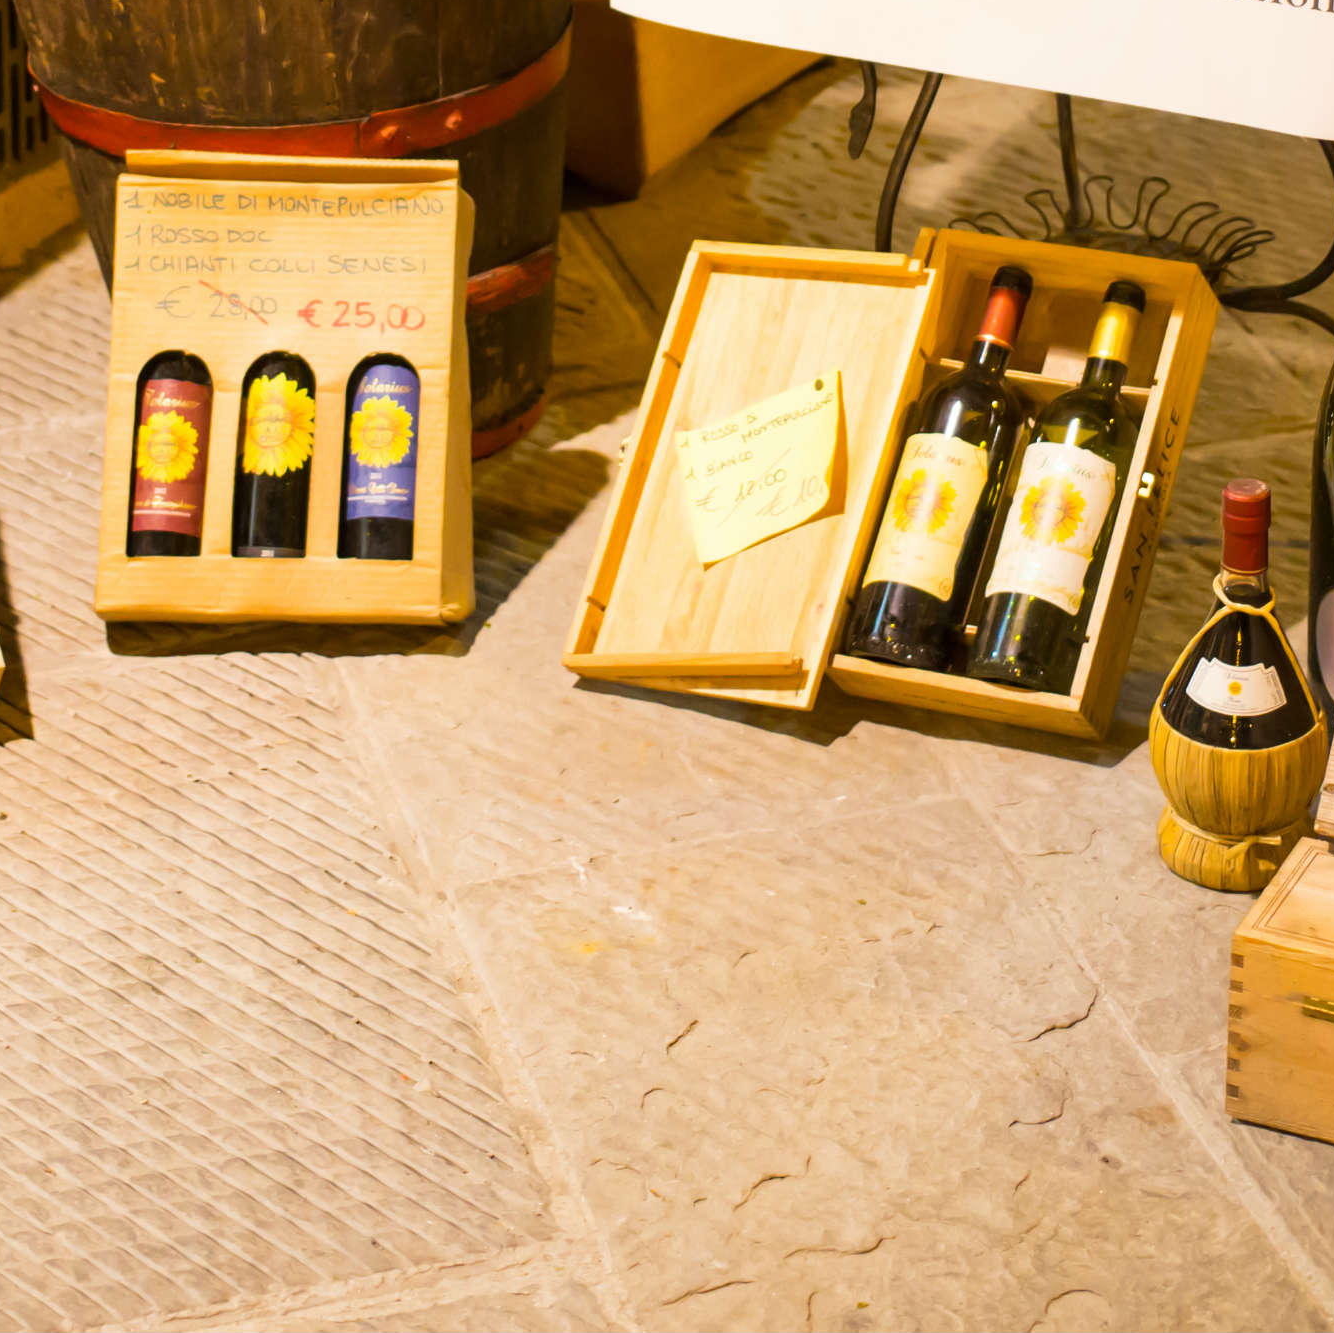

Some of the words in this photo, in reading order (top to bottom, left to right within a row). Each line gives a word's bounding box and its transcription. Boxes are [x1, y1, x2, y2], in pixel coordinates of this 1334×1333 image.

[153, 192, 226, 211] NOBILE
[237, 194, 258, 211] DI
[268, 196, 445, 217] MONTEPULCIANO
[151, 224, 220, 245] ROSSO
[227, 229, 275, 244] DOC
[149, 255, 235, 274] CHIANTI
[249, 255, 316, 274] COLLI
[327, 255, 428, 275] SENESI
